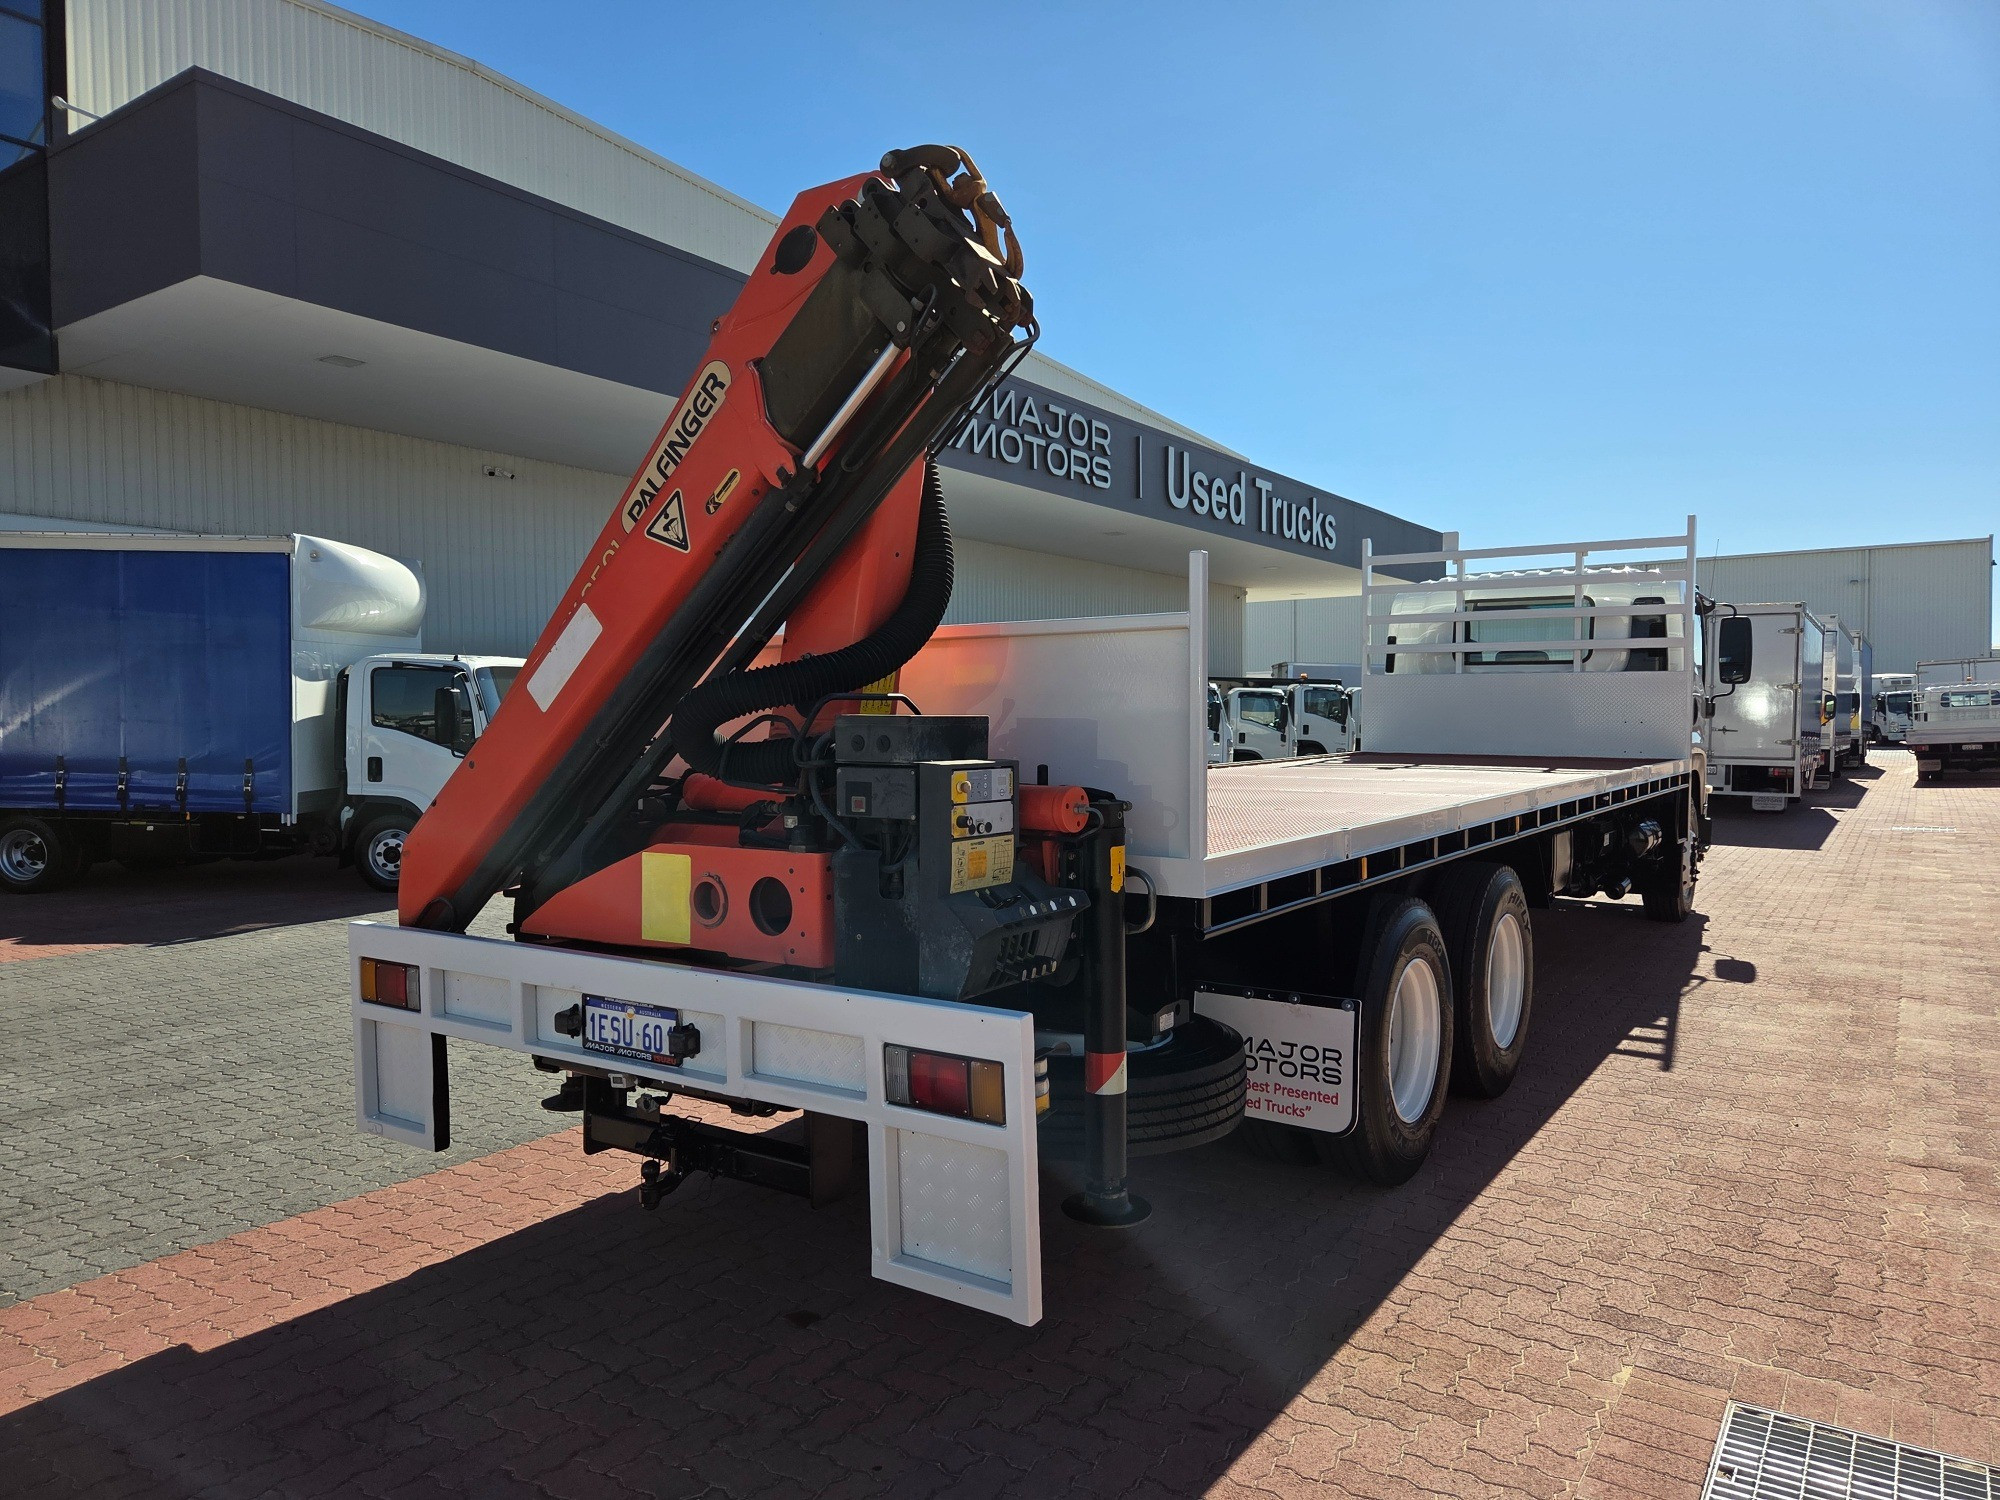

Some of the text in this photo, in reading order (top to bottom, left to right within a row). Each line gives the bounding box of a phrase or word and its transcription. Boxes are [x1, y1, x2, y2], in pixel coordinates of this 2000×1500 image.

[970, 386, 1111, 456] MAJOR
[627, 371, 727, 525] PALFINGER
[948, 415, 1111, 489] MOTORS
[1166, 445, 1337, 551] Used Trucks
[600, 1003, 662, 1018] WESTERN AUSTRALIA
[585, 1041, 677, 1066] MAJOR MOTORS ISUZU
[1246, 1056, 1342, 1085] OTORS
[1274, 1083, 1339, 1106] Presented
